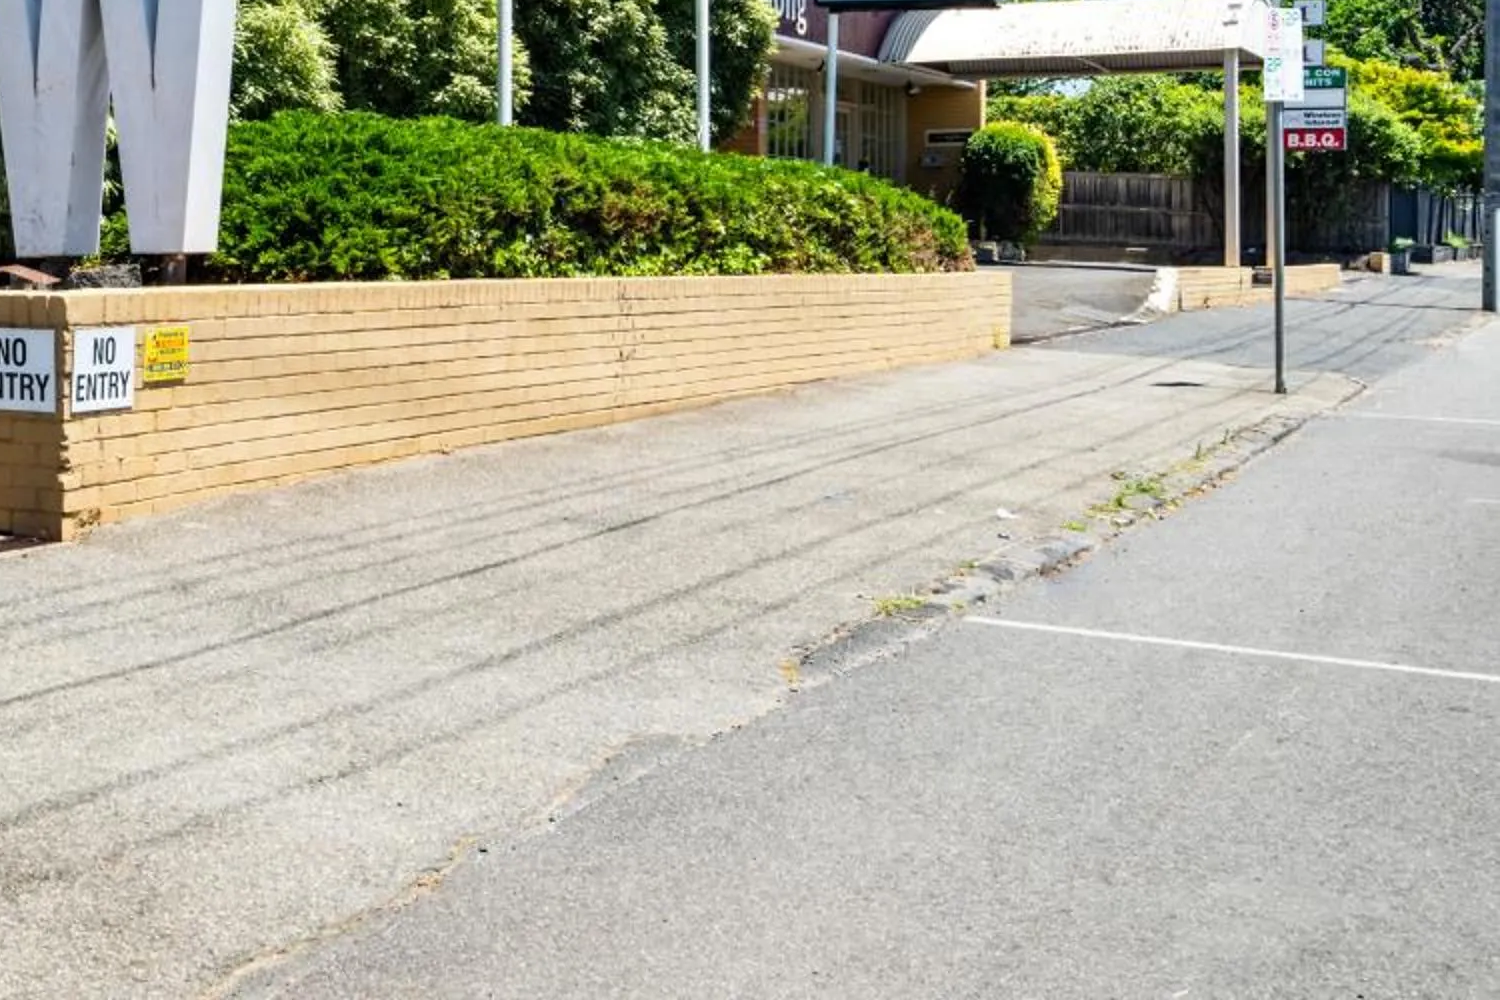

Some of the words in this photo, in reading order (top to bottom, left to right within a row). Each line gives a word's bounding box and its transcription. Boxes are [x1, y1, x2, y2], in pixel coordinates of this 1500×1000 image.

[1287, 132, 1340, 148] B.B.Q.
[92, 337, 117, 367] NO
[75, 370, 131, 403] ENTRY
